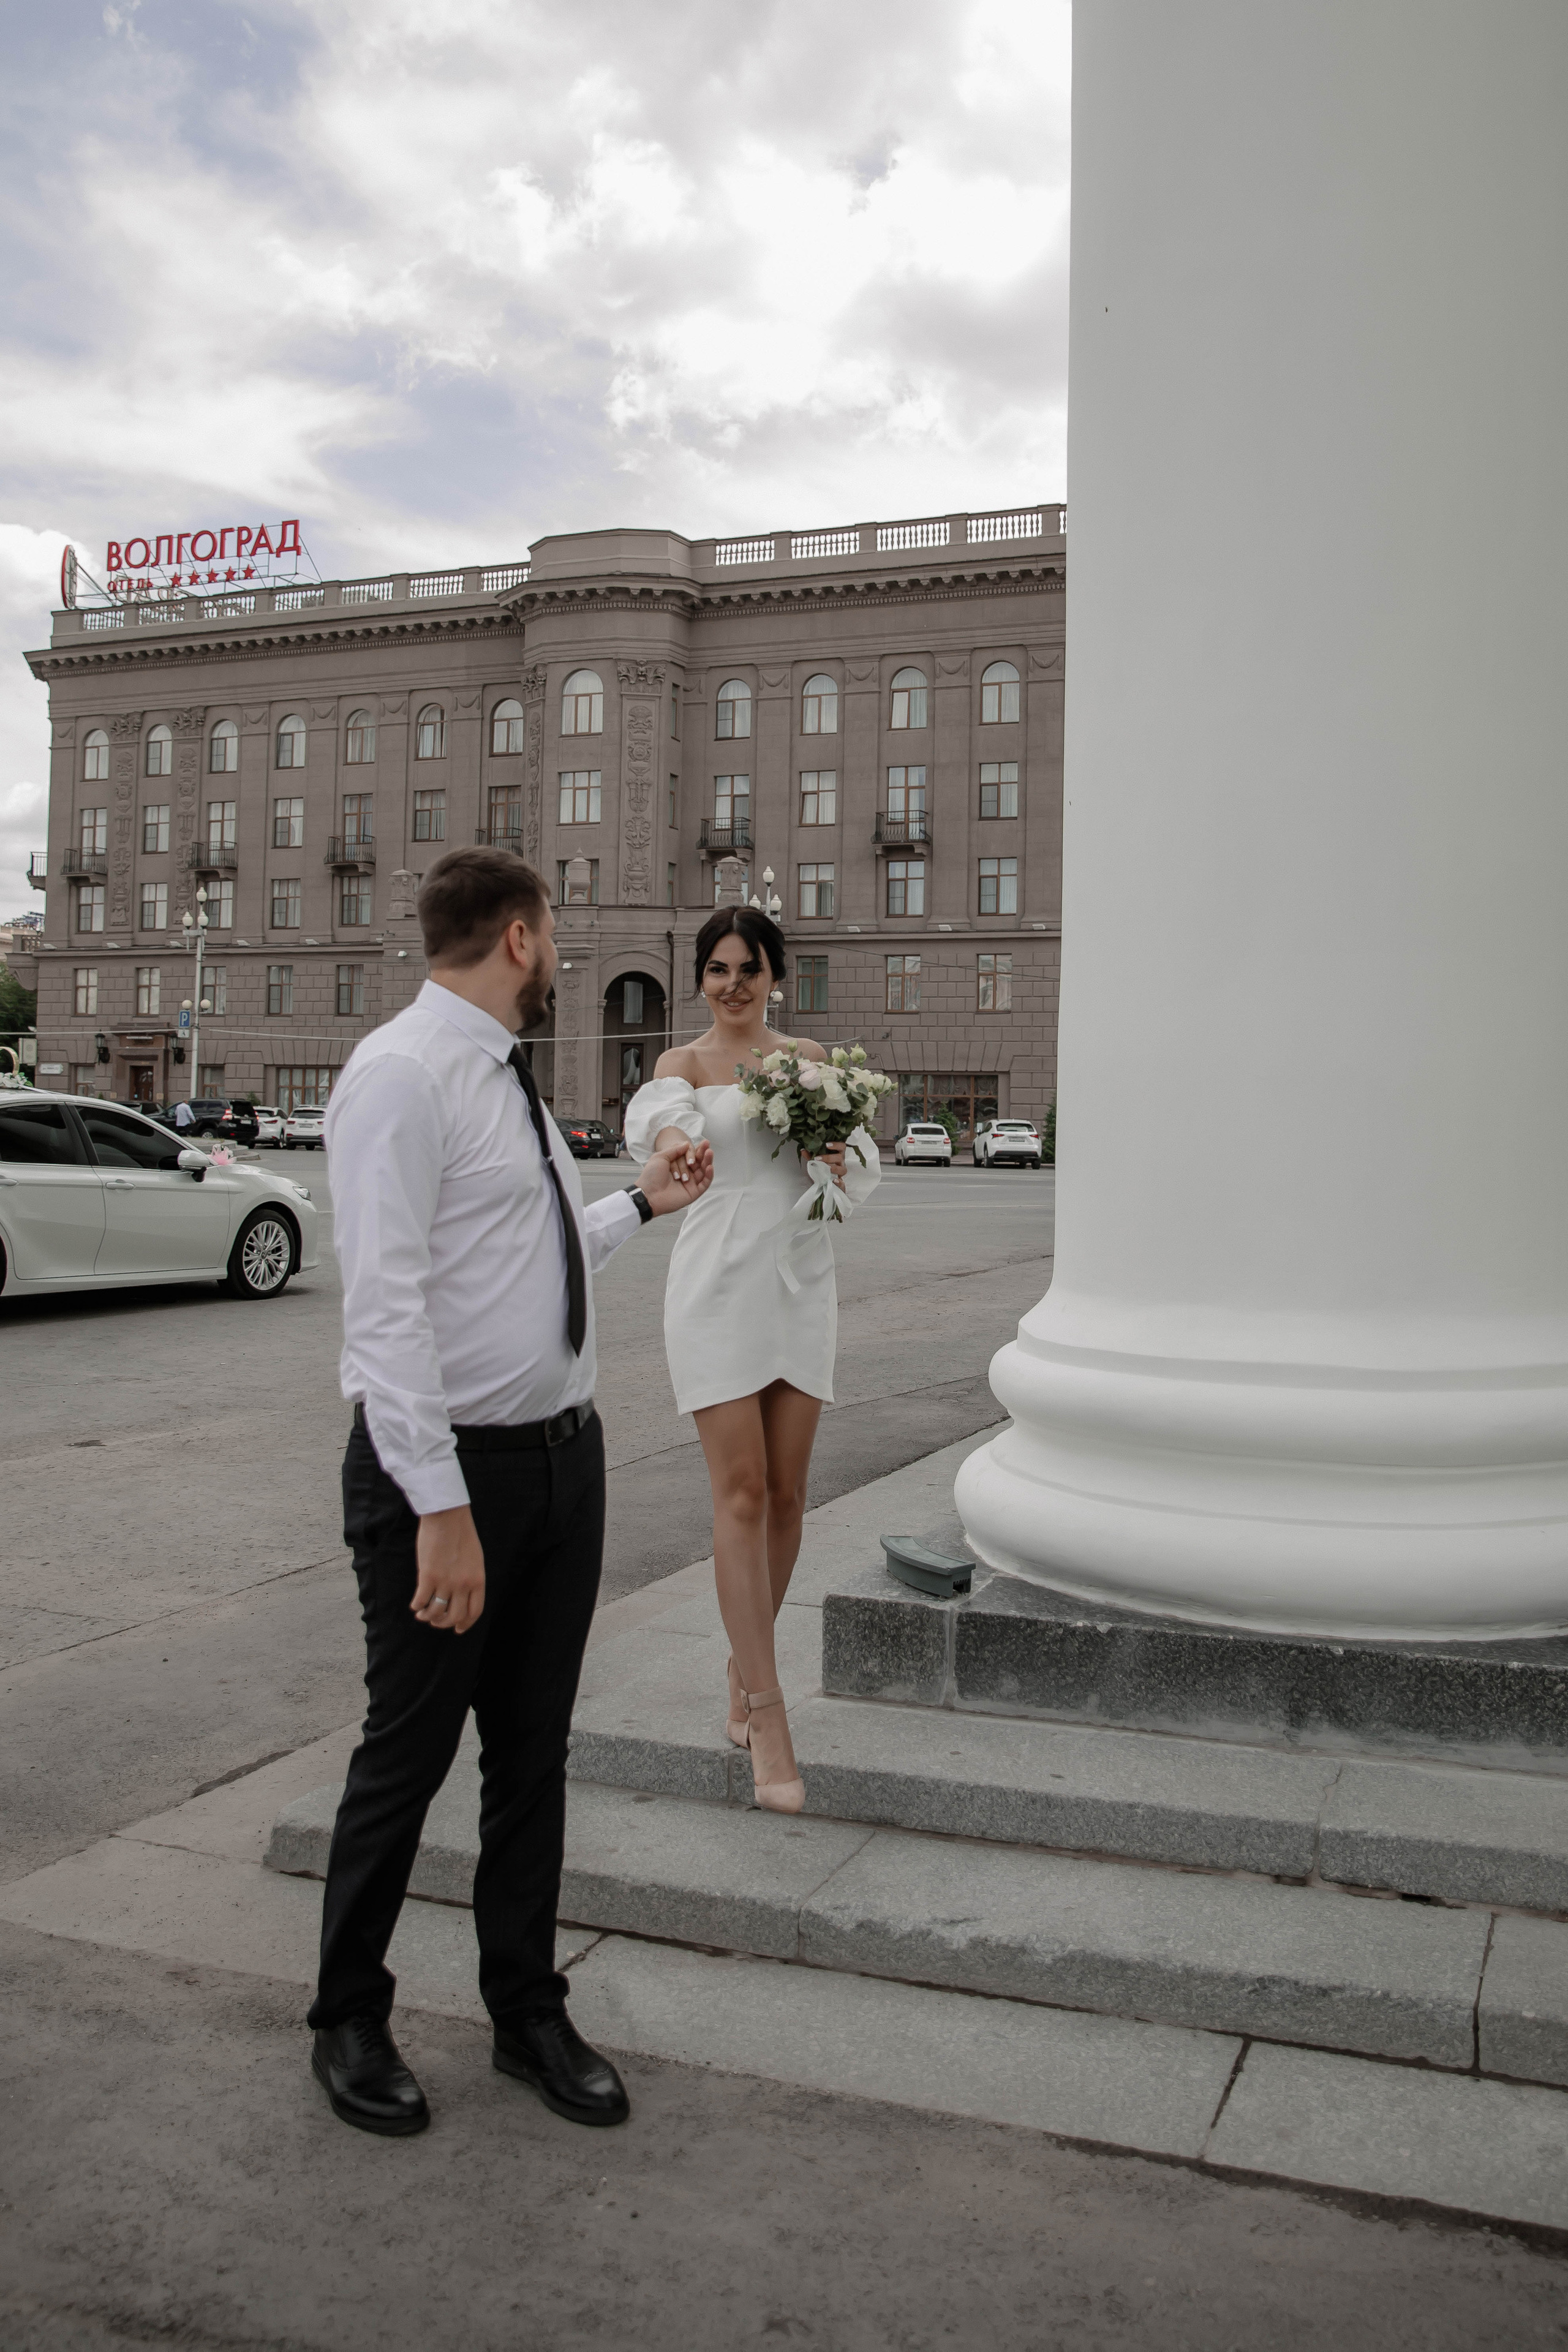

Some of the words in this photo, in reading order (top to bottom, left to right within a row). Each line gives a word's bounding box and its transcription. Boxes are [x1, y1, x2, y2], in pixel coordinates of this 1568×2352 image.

[107, 519, 301, 571] ВОЛГОГРАД
[108, 578, 153, 592] ОТЕЛЬ
[181, 1012, 188, 1026] P
